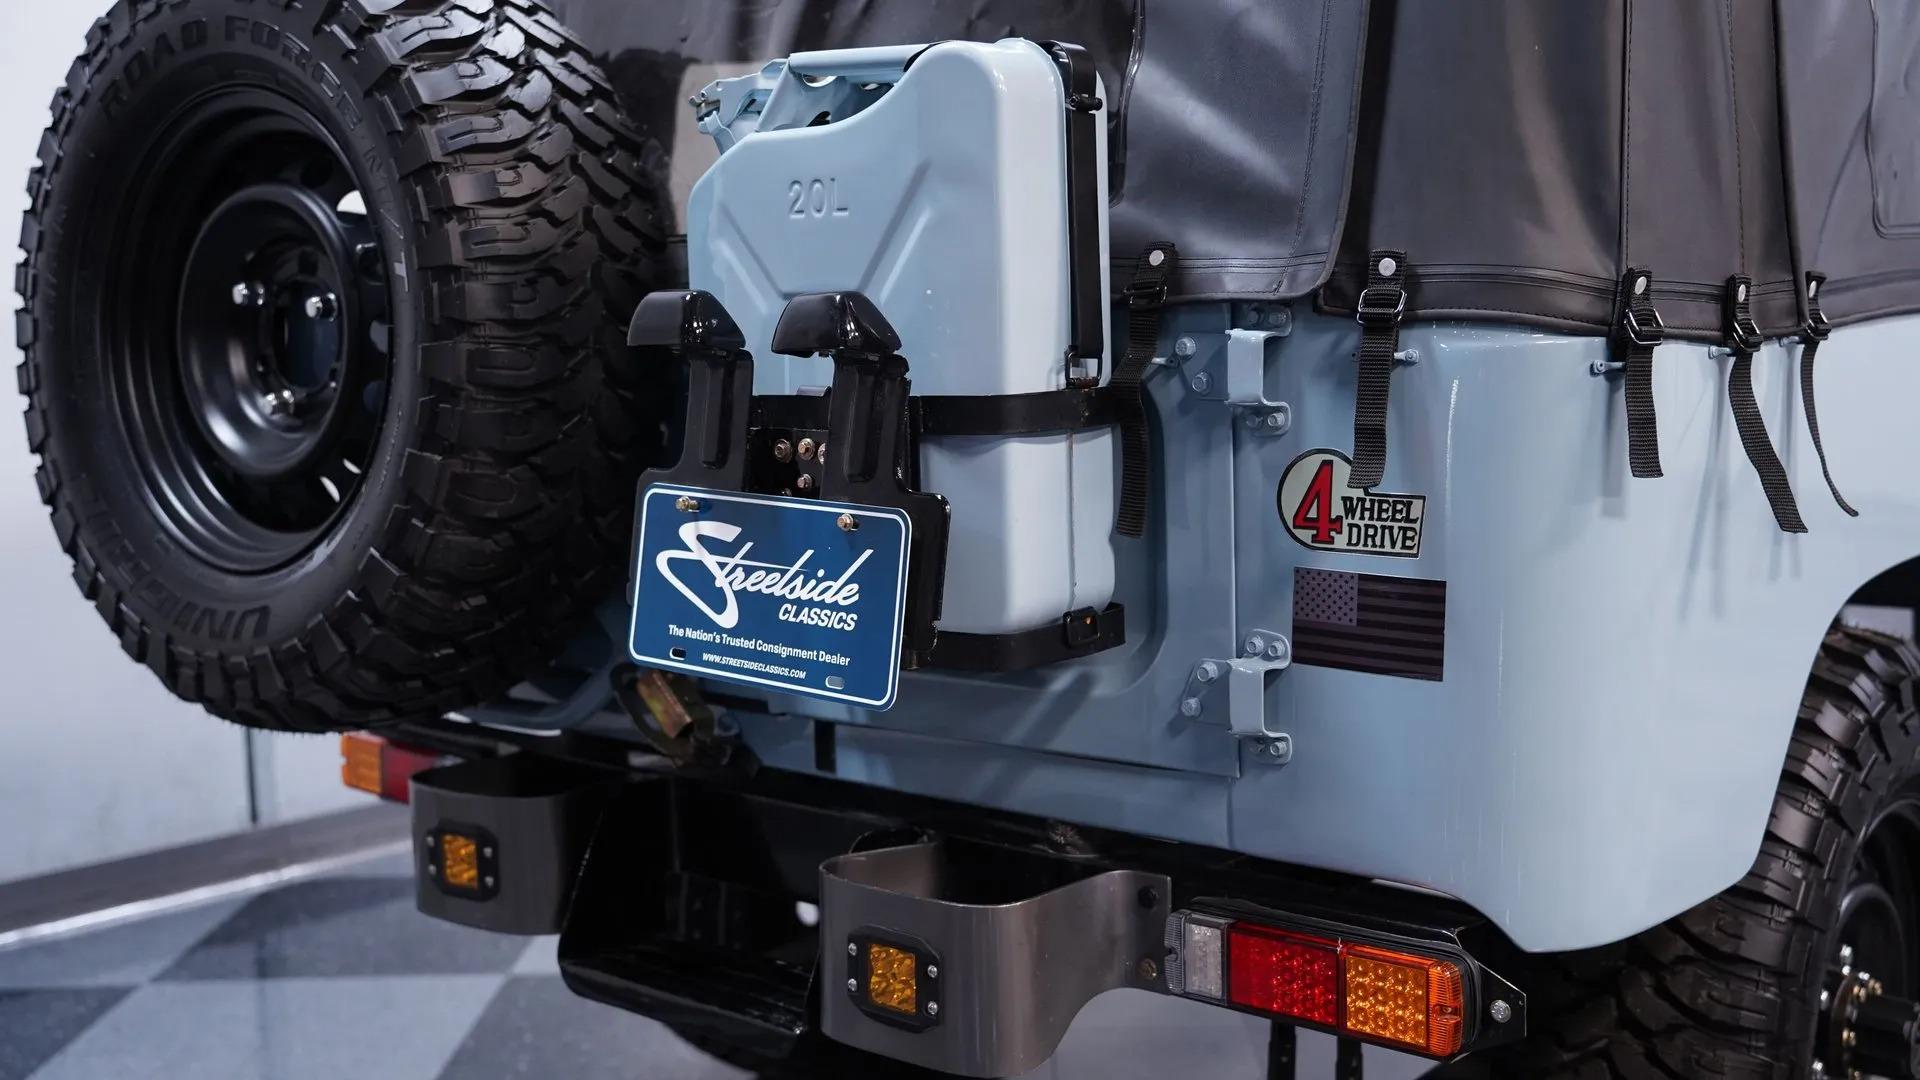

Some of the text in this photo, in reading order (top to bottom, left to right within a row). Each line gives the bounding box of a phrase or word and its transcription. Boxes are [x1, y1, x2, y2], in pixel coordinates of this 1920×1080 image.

[101, 18, 208, 119] ROAD
[224, 14, 362, 130] FORCE
[788, 177, 849, 219] 20L
[1292, 459, 1343, 545] 4
[1342, 496, 1419, 523] WHEEL
[1346, 524, 1418, 549] DRIVE
[656, 520, 874, 629] Streetside
[778, 603, 857, 631] CLASSICS
[668, 624, 851, 667] The Nation's Trusted Consignment Dealer
[702, 652, 806, 679] WWW.STREETSIDECLASSICS.COM
